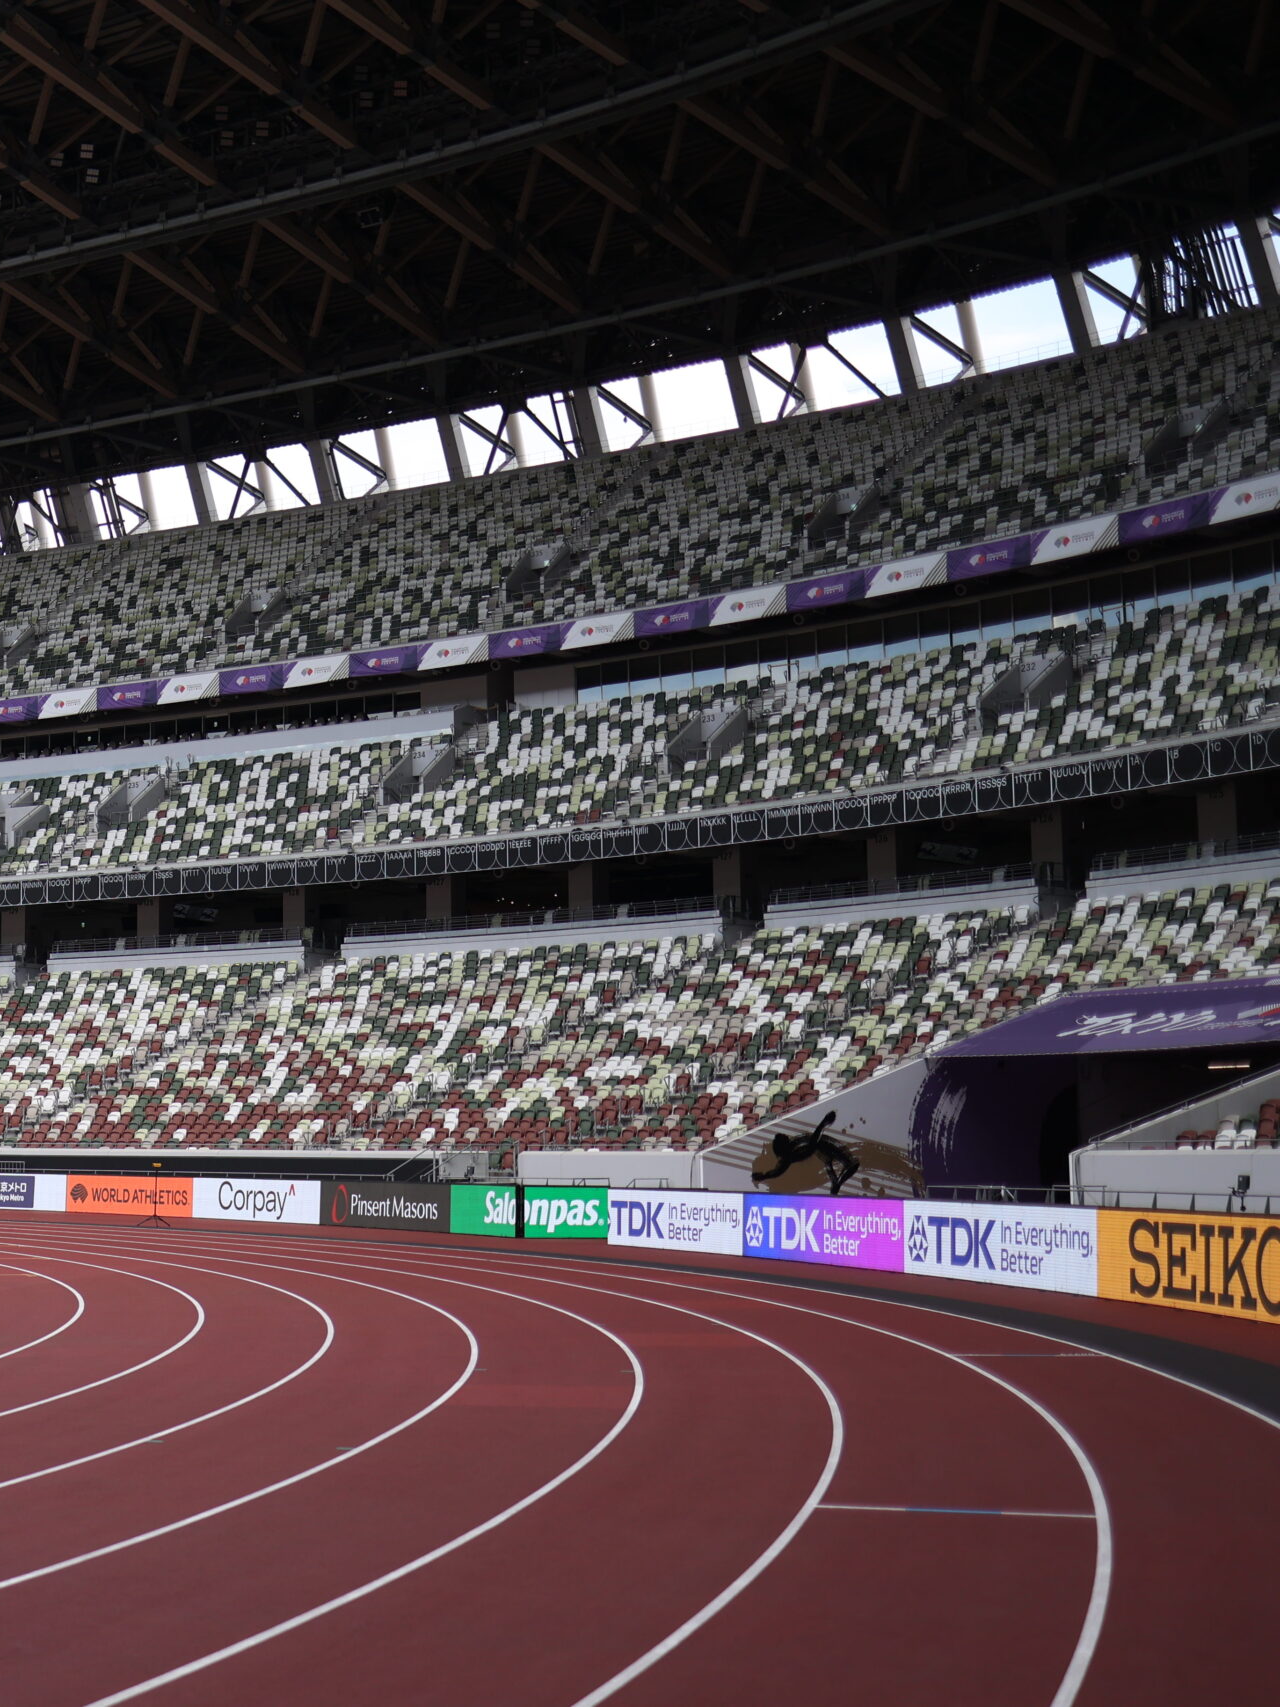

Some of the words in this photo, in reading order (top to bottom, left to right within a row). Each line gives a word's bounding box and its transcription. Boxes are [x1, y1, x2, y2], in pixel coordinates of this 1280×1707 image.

[1021, 663, 1036, 672] 232
[702, 714, 715, 723] 233
[1211, 741, 1223, 753] 1C
[1253, 734, 1263, 745] 1D
[413, 751, 426, 760] 234
[1130, 755, 1141, 767] 1A
[1169, 749, 1180, 760] 1B
[1092, 759, 1124, 773] 1VVVVV
[129, 781, 139, 789] 235
[978, 777, 1007, 789] 1SSSSS
[387, 852, 412, 861] 1AAAAA
[10, 1193, 24, 1202] Metro
[92, 1187, 130, 1203] WORLD
[132, 1189, 188, 1206] ATHLETICS
[218, 1181, 288, 1220] Corpay
[351, 1193, 390, 1216] Pinsent
[391, 1196, 438, 1220] Masons
[610, 1200, 665, 1239] TDK
[668, 1203, 678, 1220] In
[680, 1203, 740, 1229] Everything,
[668, 1223, 703, 1242] Better
[762, 1207, 820, 1253] TDK
[823, 1210, 833, 1231] In
[835, 1210, 901, 1241] Everything,
[823, 1234, 860, 1257] Better
[927, 1216, 996, 1270] TDK
[1000, 1220, 1012, 1244] In
[1015, 1221, 1093, 1258] Everything,
[1000, 1248, 1044, 1276] Better
